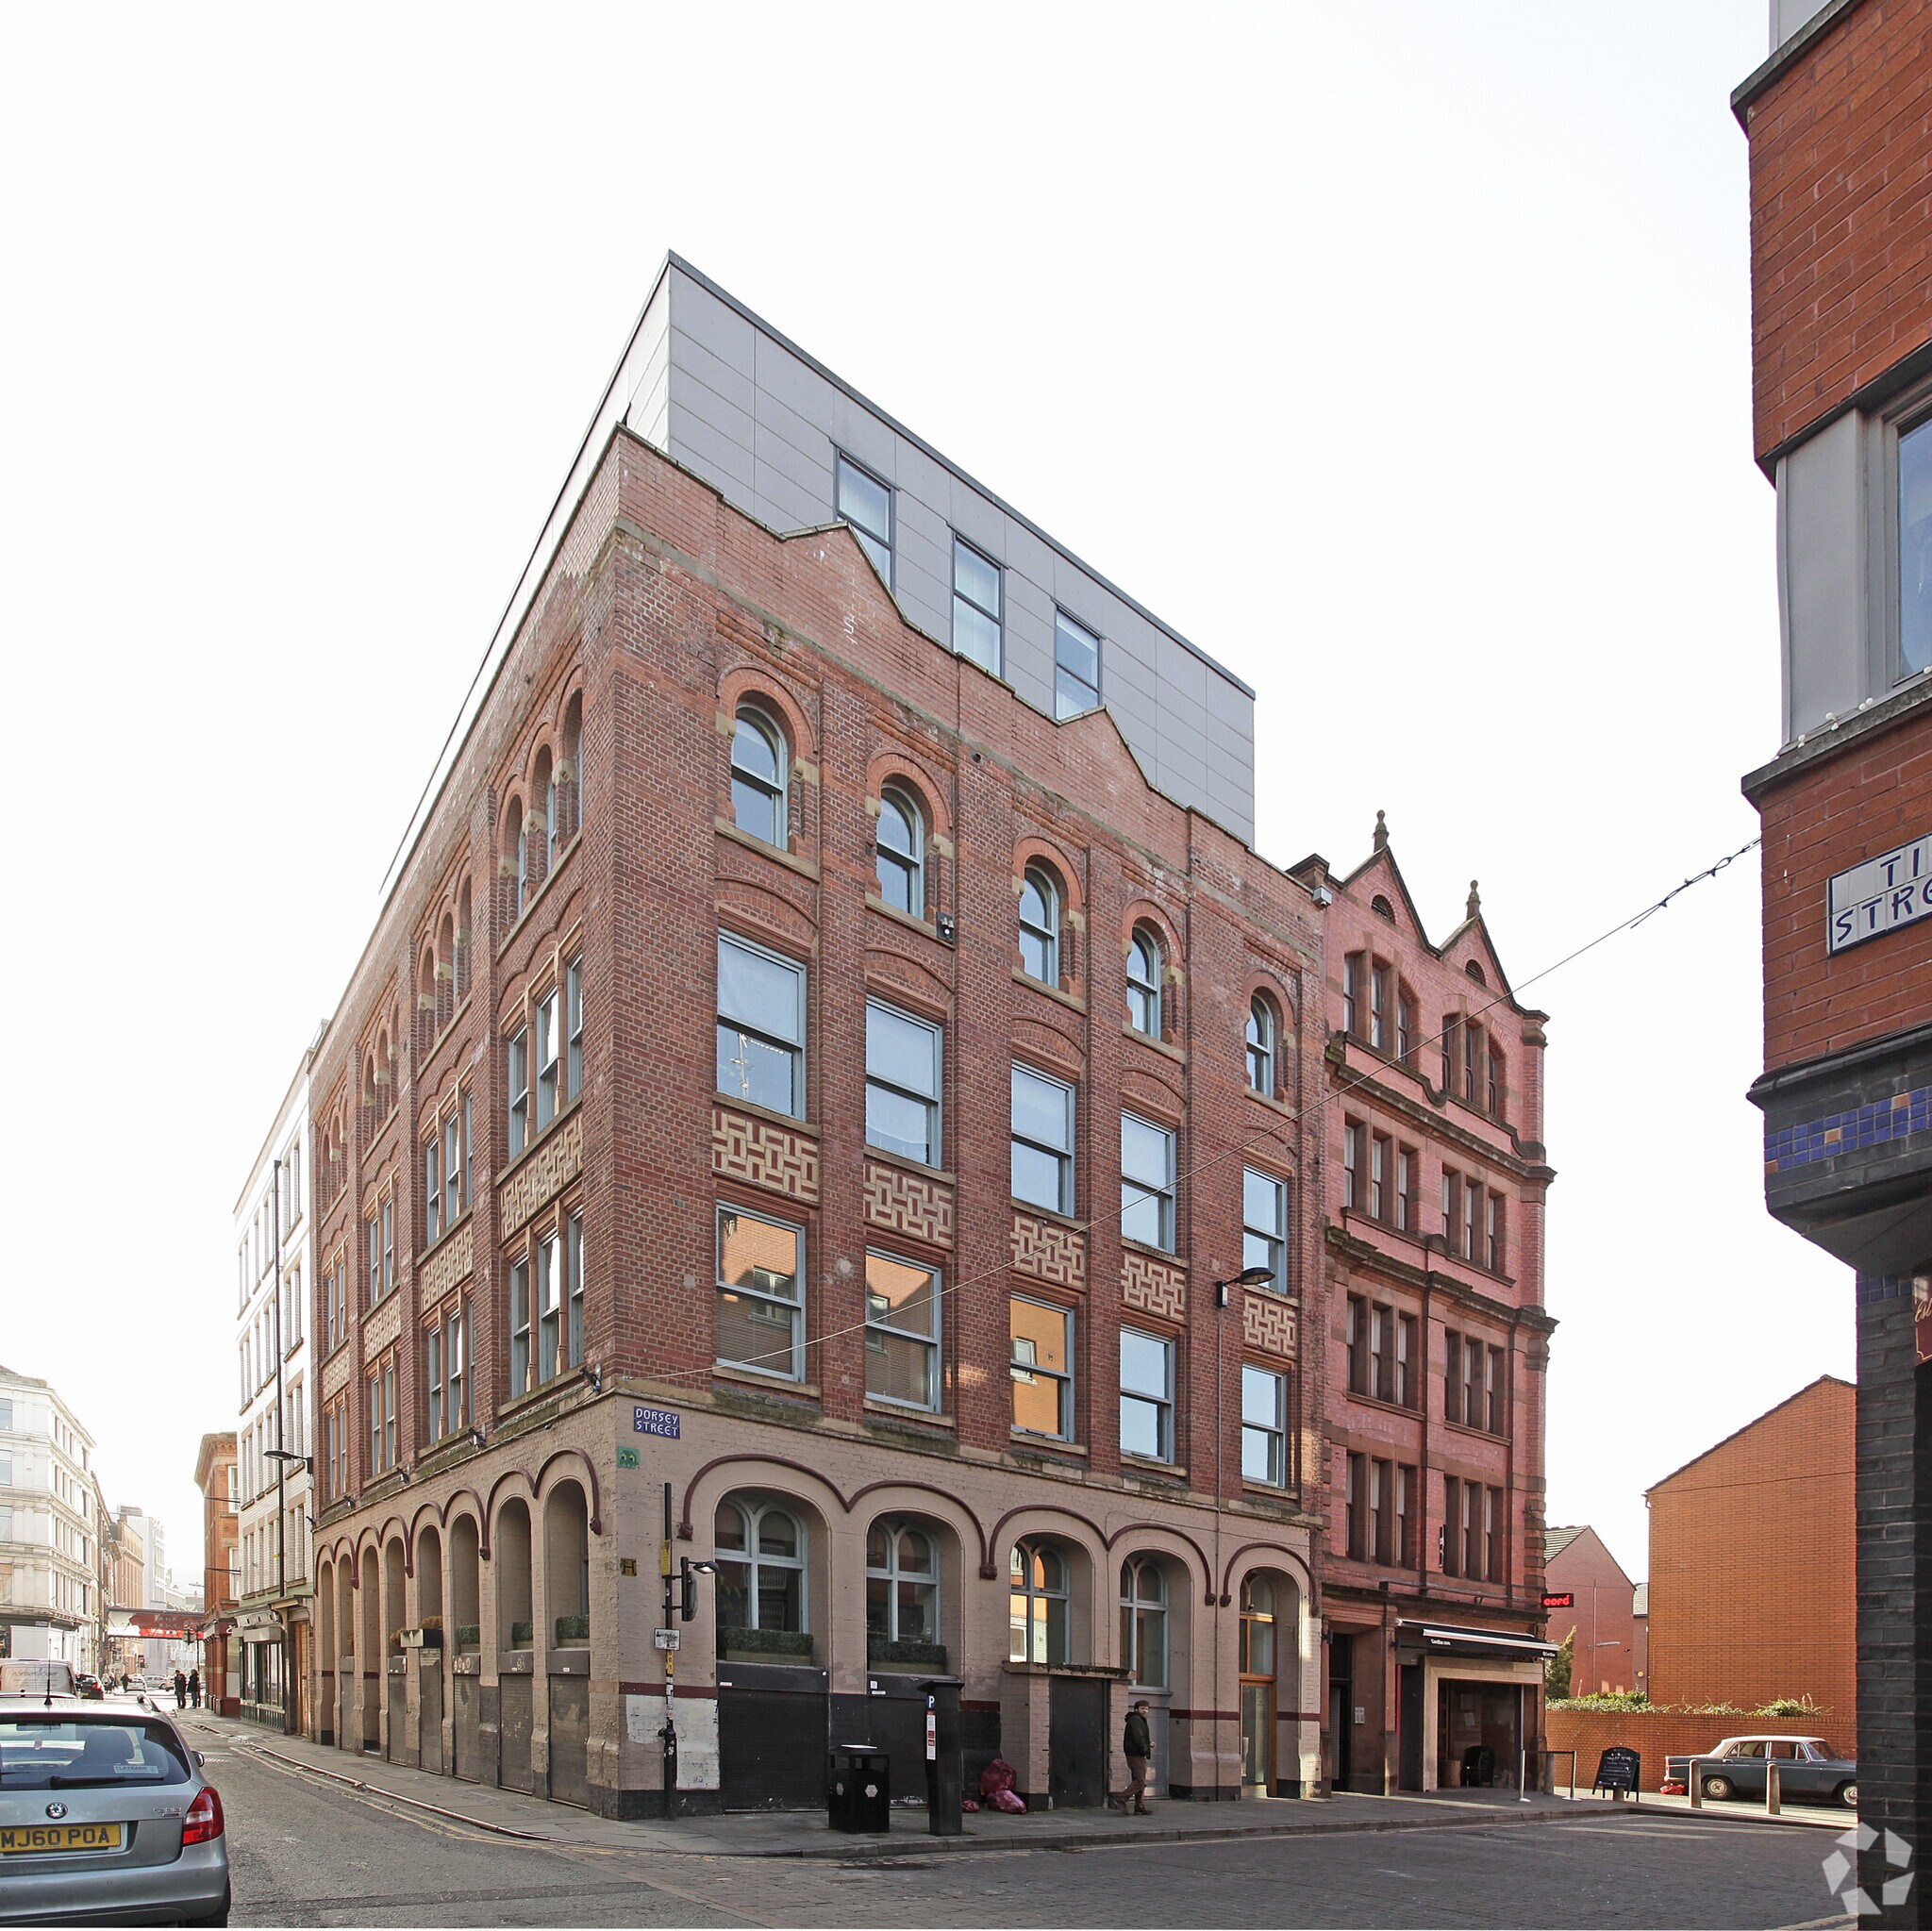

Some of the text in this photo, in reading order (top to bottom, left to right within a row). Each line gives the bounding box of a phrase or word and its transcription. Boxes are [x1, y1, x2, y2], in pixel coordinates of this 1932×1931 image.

[1880, 846, 1932, 887] TI
[636, 1408, 678, 1424] DORSEY
[636, 1421, 678, 1436] STREET
[928, 1695, 935, 1708] P
[1, 1828, 110, 1848] MJ60 POA
